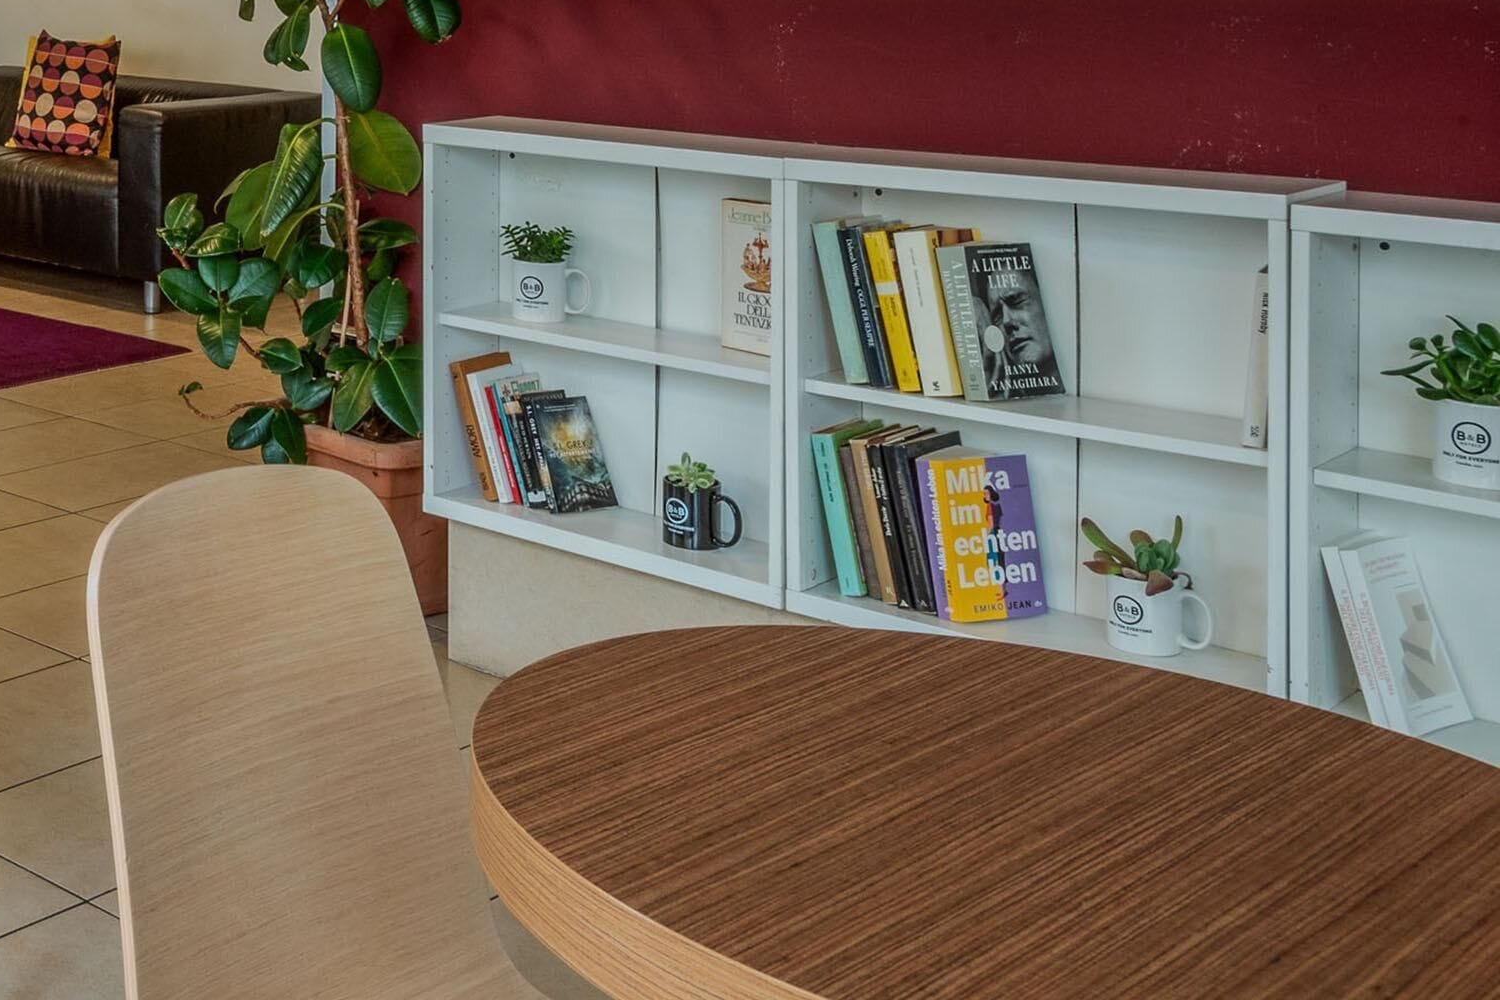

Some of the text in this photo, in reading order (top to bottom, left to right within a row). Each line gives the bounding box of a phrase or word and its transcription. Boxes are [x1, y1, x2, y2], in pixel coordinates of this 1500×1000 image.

[971, 256, 1031, 273] A LITTLE
[988, 273, 1019, 289] LIFE
[952, 261, 980, 368] A LITTLE LIFE
[1004, 363, 1039, 376] HANYA
[990, 376, 1058, 391] YANAGIHARA
[465, 424, 482, 457] AMORI
[1457, 430, 1486, 444] B&B
[945, 465, 1010, 495] Mika
[927, 469, 947, 571] Mika im echten Leben
[949, 499, 982, 526] im
[954, 527, 1037, 556] echten
[957, 559, 1037, 589] Leben
[974, 602, 1004, 614] EMIKO
[1008, 601, 1032, 610] JEAN
